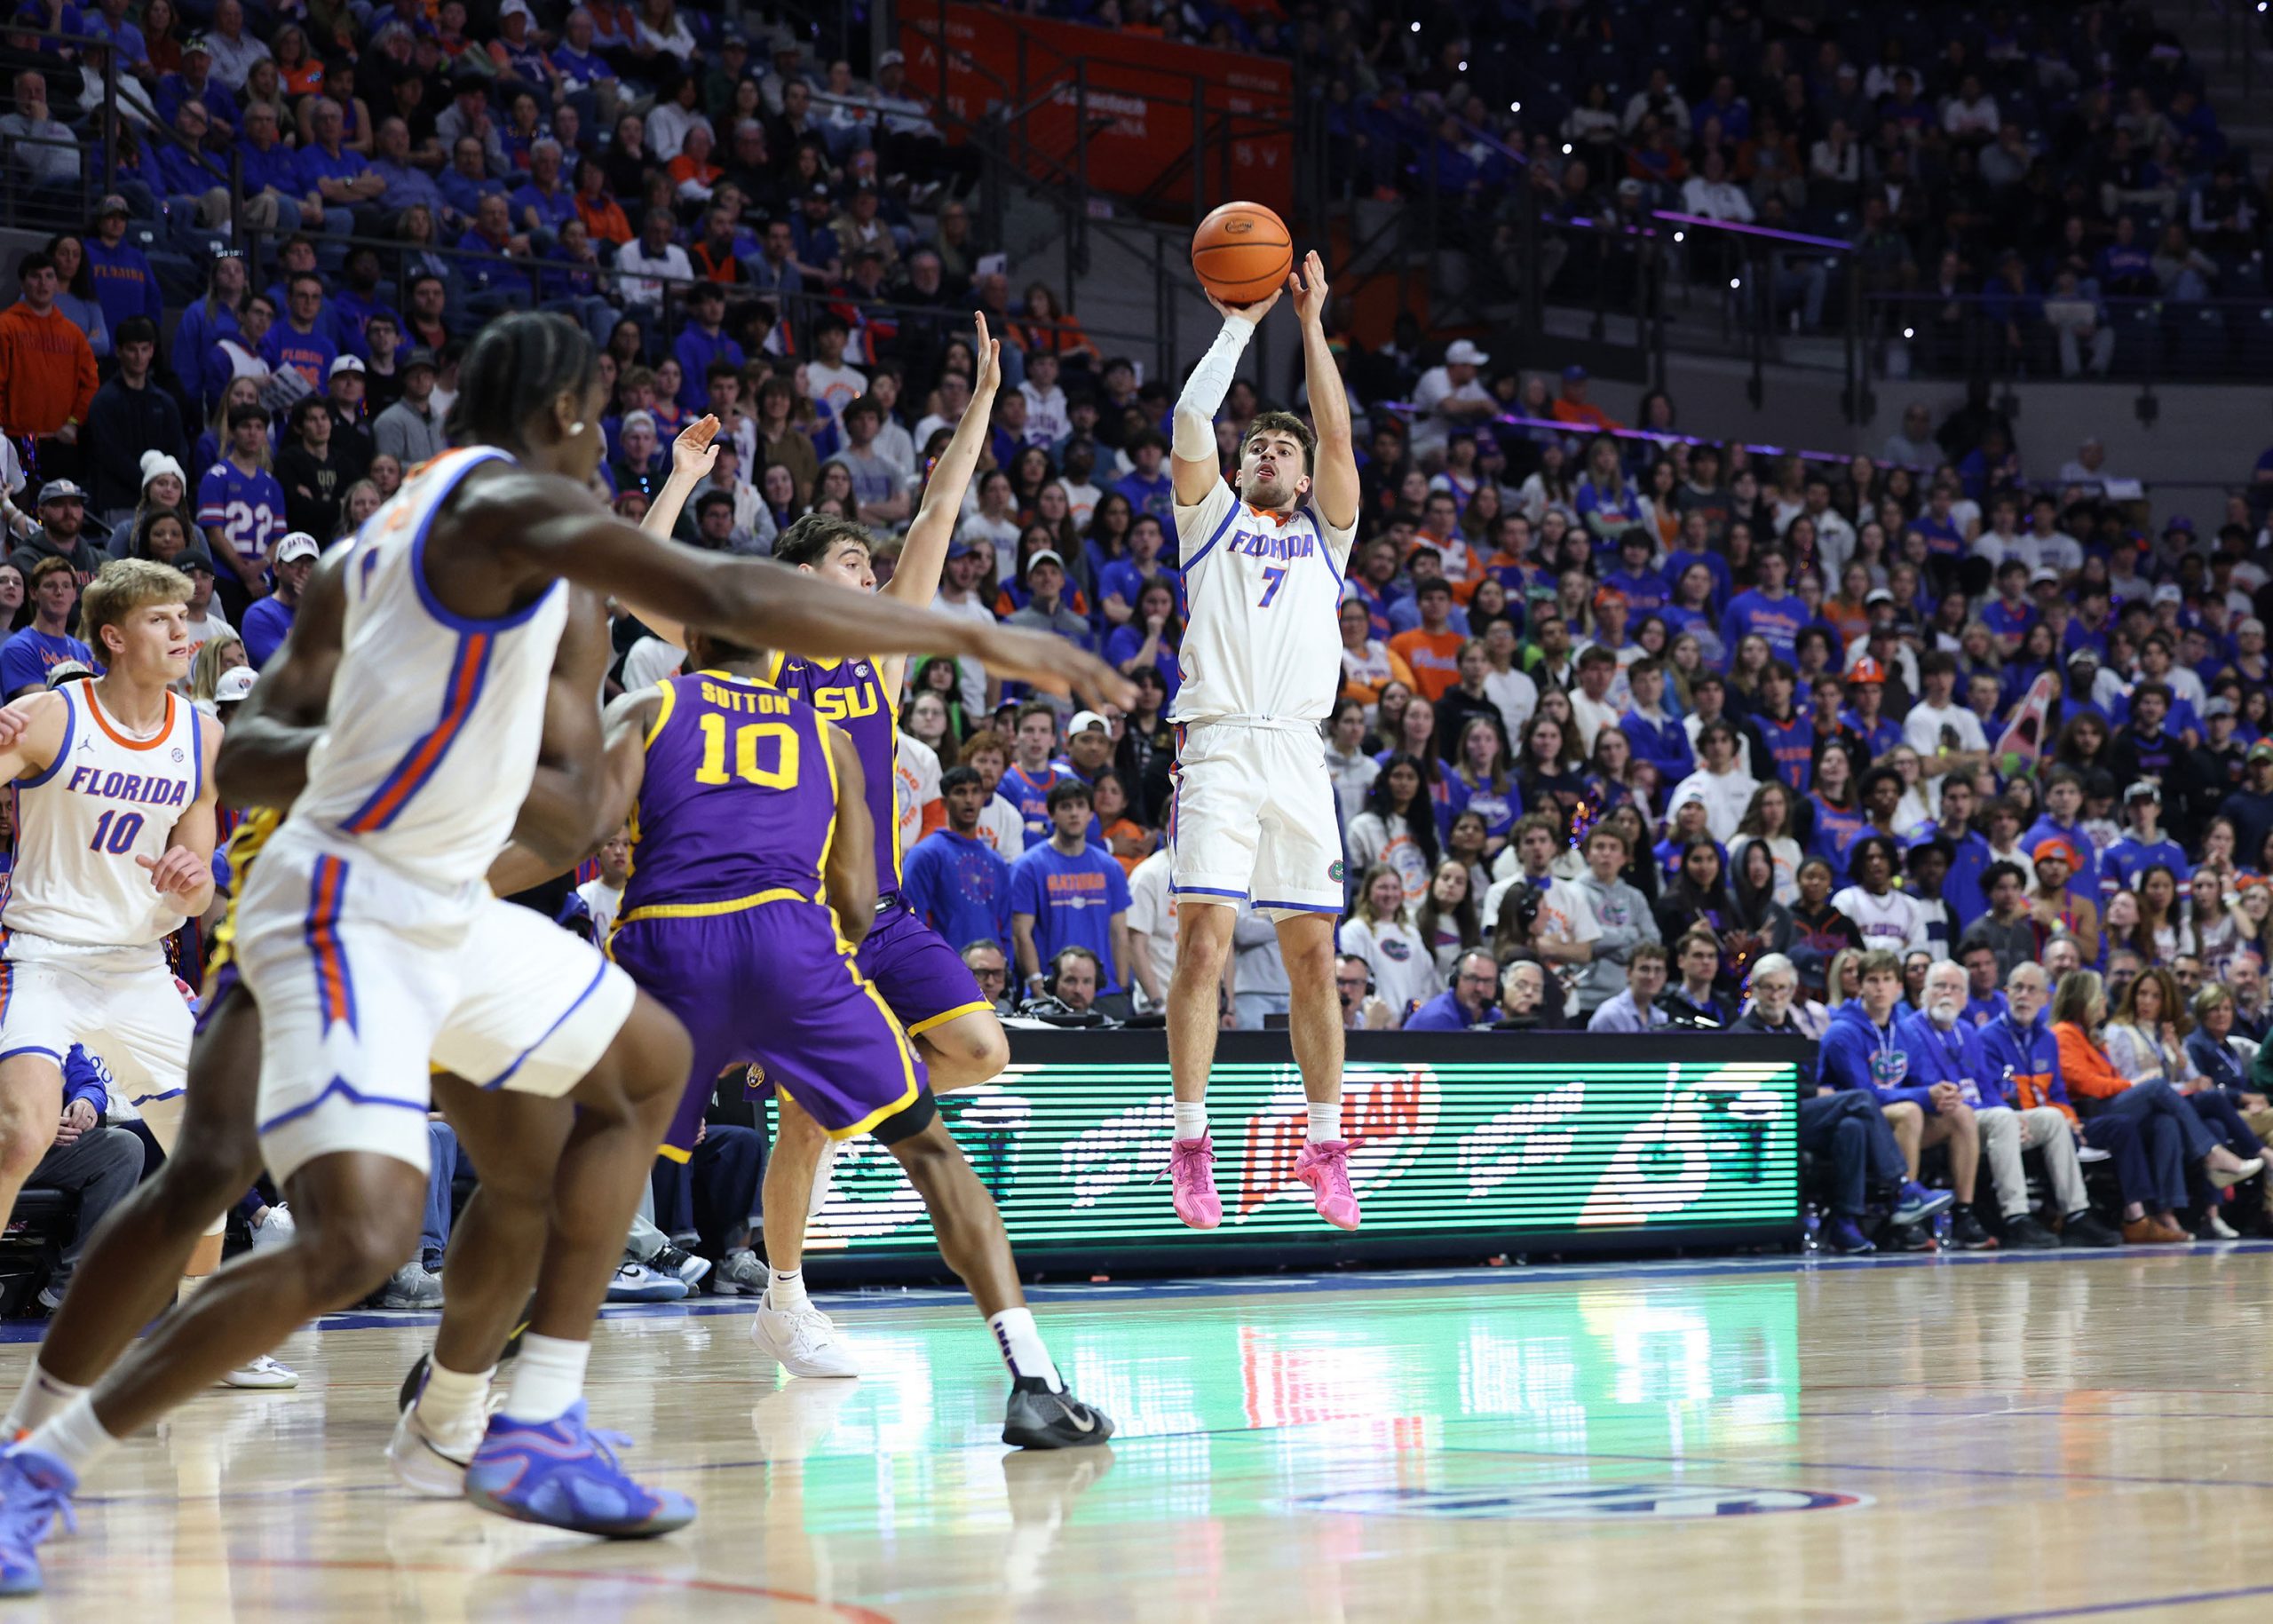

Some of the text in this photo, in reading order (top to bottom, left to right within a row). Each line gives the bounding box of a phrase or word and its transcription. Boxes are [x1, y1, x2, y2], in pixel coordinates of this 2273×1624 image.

[225, 500, 273, 555] 22
[1227, 529, 1315, 562] FLORIDA
[1257, 566, 1287, 608] 7
[701, 681, 791, 716] SUTTON
[787, 681, 879, 721] SU
[695, 712, 799, 791] 10
[67, 765, 187, 807] FLORIDA
[90, 810, 145, 854] 10
